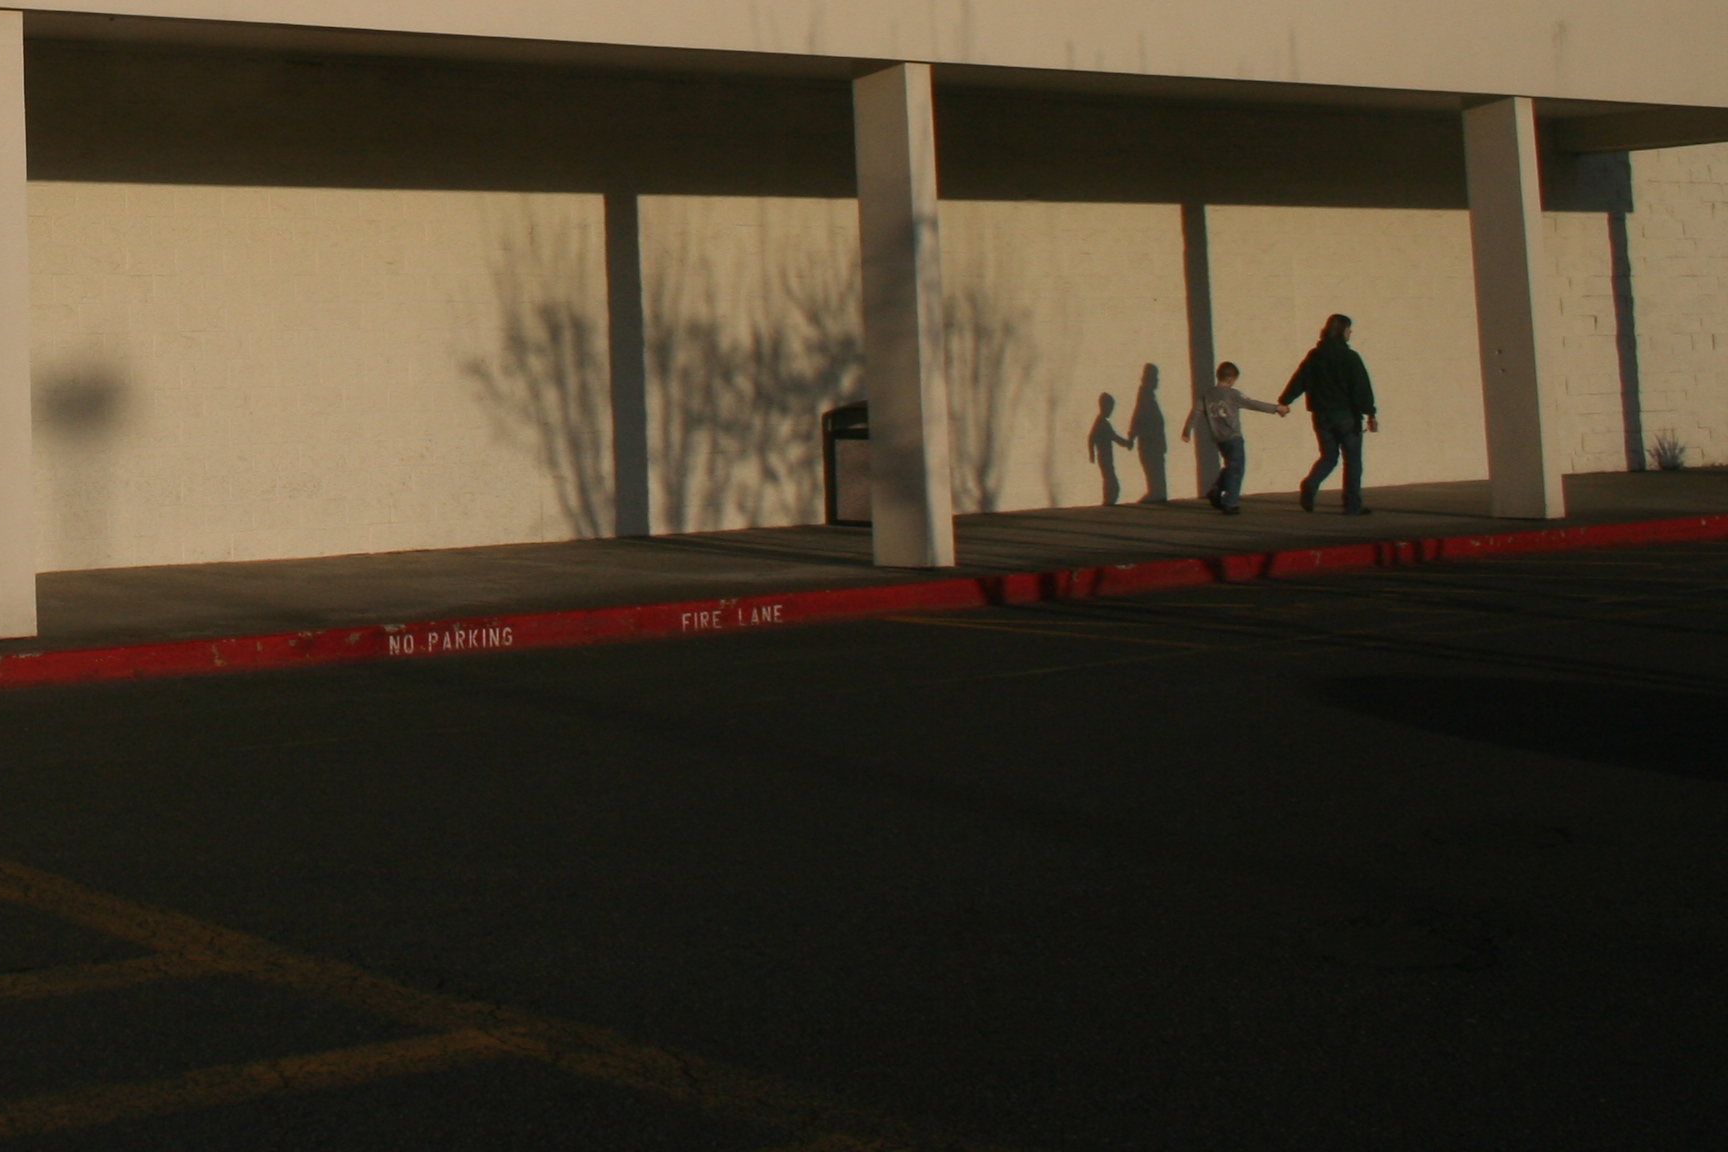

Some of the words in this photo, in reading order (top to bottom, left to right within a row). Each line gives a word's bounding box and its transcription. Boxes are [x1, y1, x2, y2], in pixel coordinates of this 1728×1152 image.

[681, 610, 722, 632] FIRE
[738, 604, 784, 626] LANE
[388, 634, 415, 655] NO
[428, 626, 514, 651] PARKING
